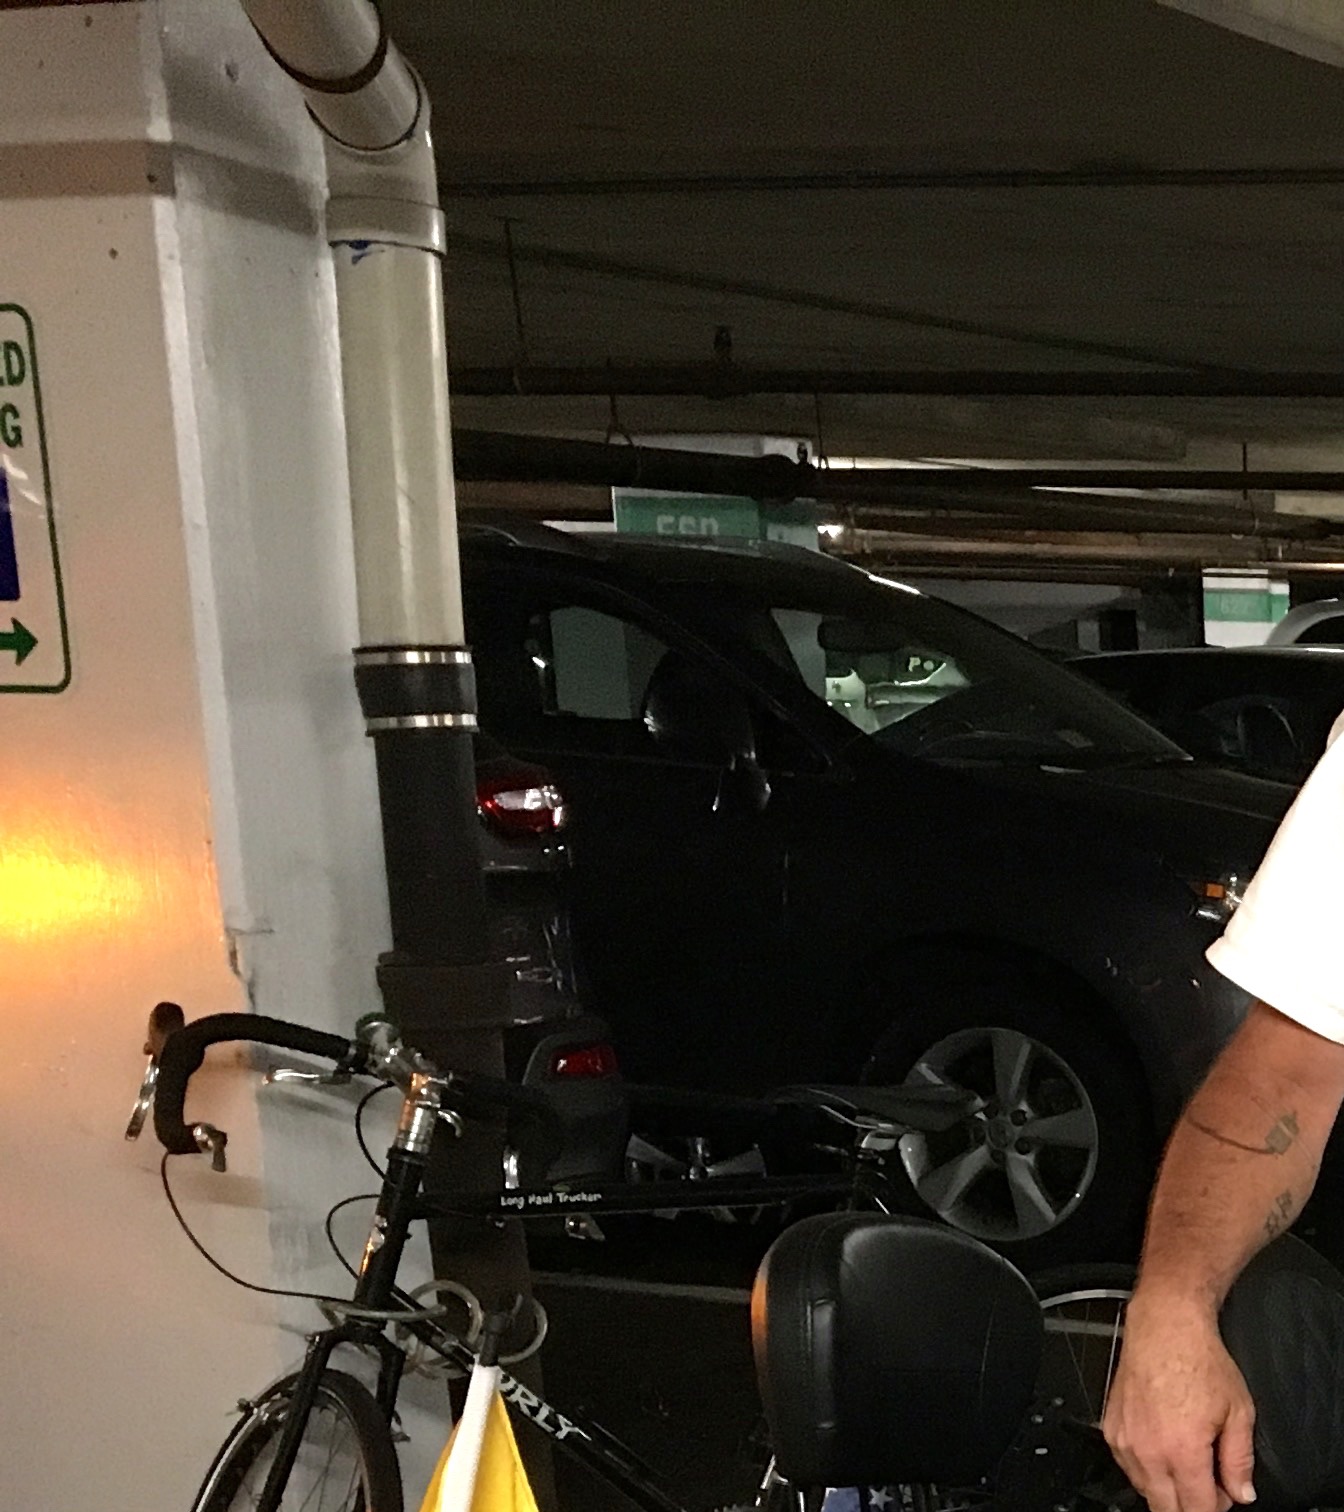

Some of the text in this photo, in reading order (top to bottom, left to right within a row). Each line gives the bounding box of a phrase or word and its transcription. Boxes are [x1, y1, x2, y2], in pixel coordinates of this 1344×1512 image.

[500, 1195, 525, 1210] Long
[556, 1191, 602, 1203] Trucker
[497, 1372, 593, 1442] URLY
